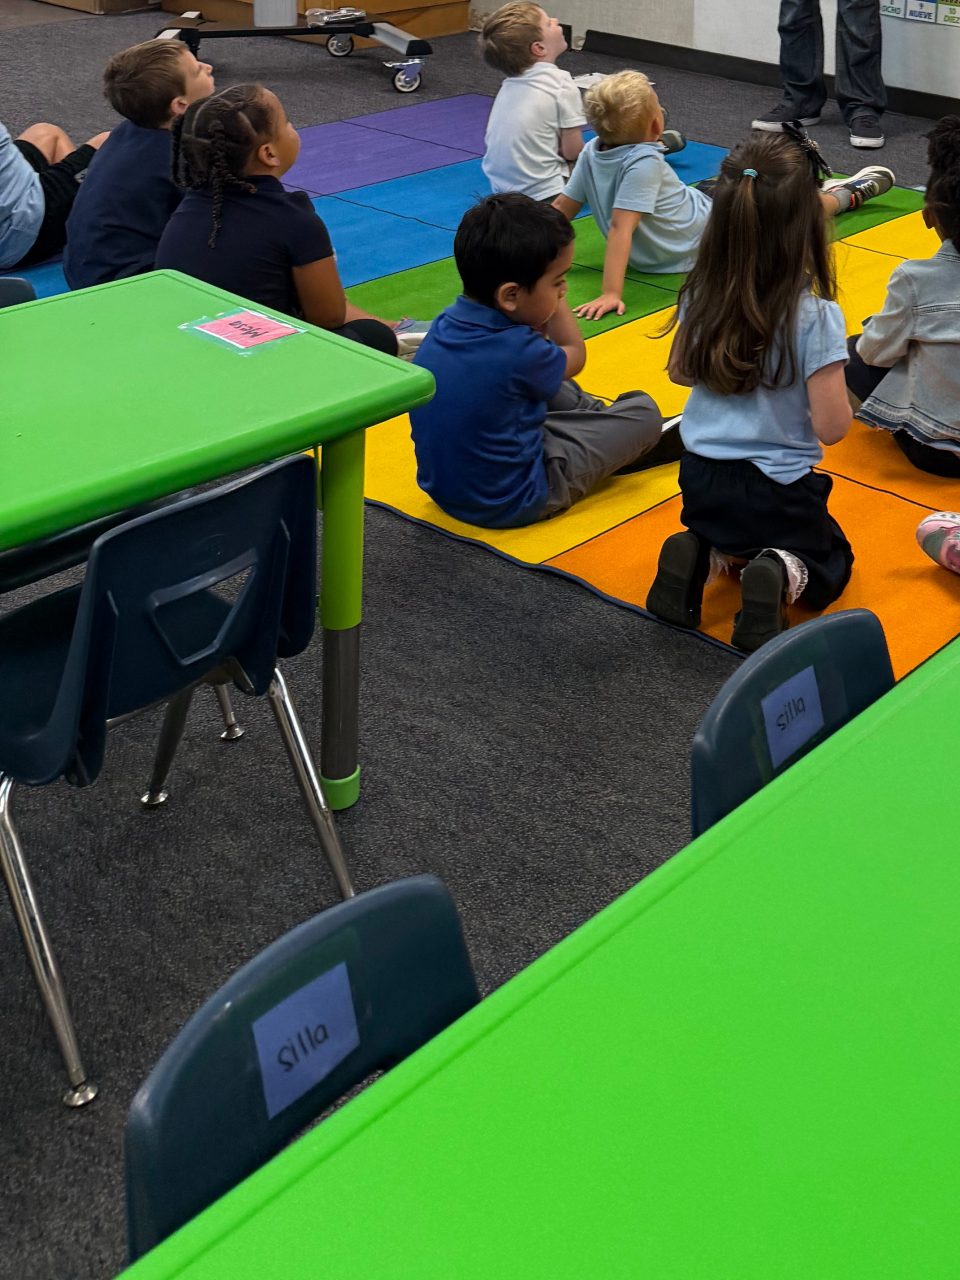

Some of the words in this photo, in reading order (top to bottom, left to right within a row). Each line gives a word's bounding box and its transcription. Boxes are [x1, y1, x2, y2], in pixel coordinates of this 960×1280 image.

[908, 10, 933, 20] NUEVE
[943, 14, 960, 24] DIEZ
[228, 320, 269, 339] Mesa
